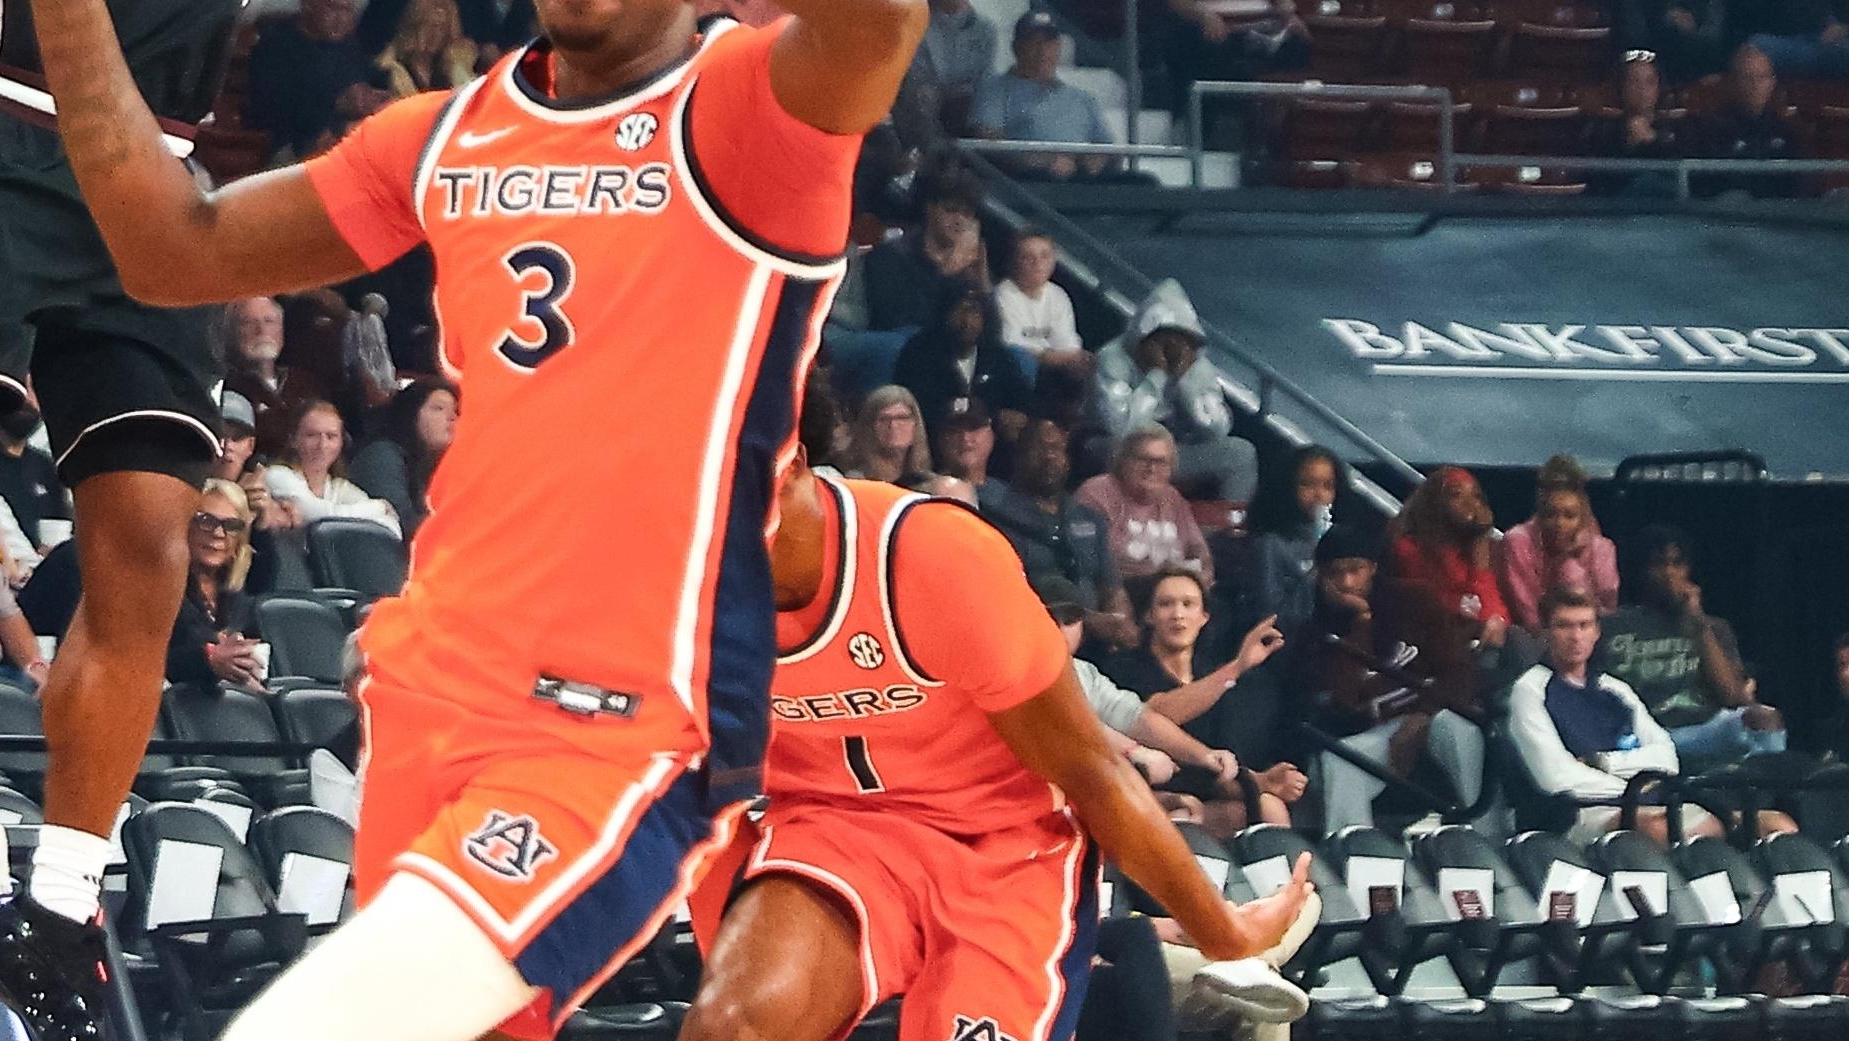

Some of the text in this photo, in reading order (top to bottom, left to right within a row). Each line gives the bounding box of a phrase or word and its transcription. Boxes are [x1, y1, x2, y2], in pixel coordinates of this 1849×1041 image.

[434, 162, 672, 222] TIGERS
[493, 240, 576, 374] 3
[848, 632, 886, 670] SEC
[772, 683, 928, 723] GERS
[841, 735, 886, 794] 1
